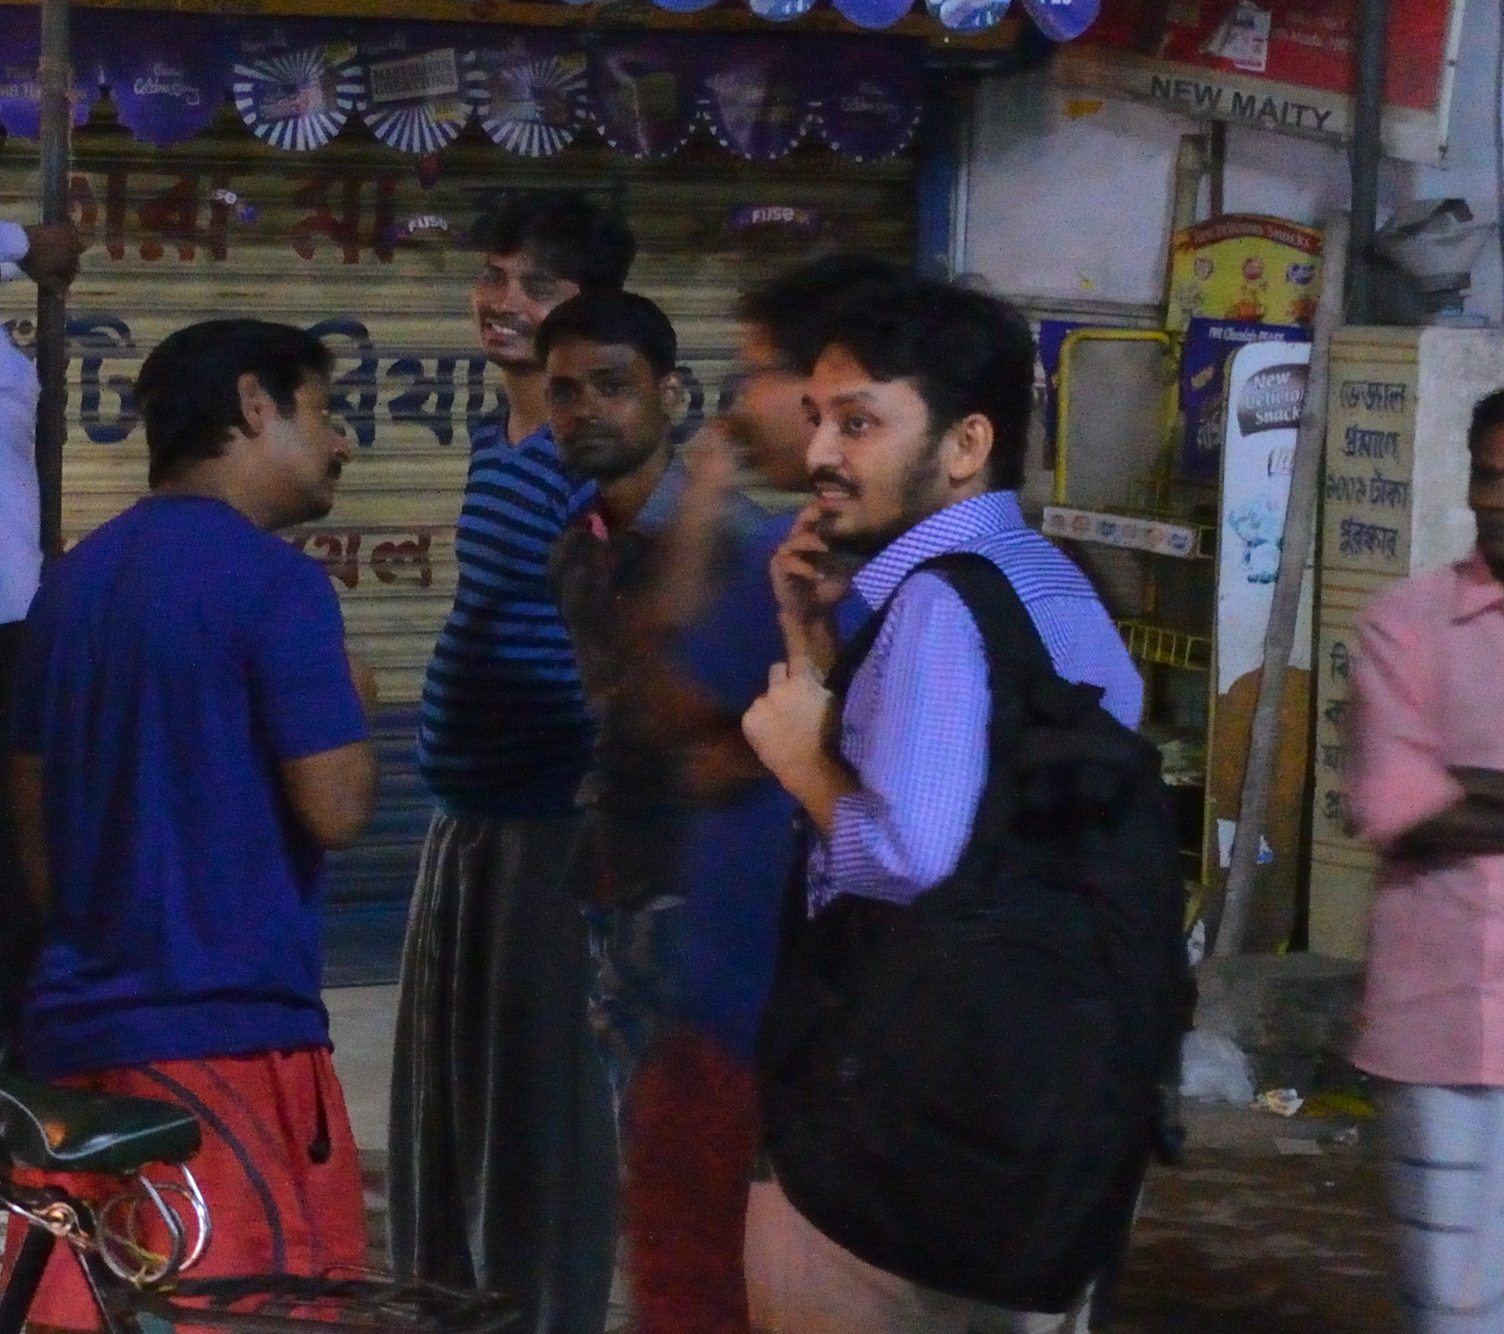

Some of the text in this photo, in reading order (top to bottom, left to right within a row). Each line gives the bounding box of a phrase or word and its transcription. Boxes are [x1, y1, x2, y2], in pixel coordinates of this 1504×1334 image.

[1149, 76, 1332, 132] NEW MAITY
[1254, 371, 1291, 387] New
[1245, 389, 1301, 409] Delicio
[1255, 406, 1301, 425] Snack
